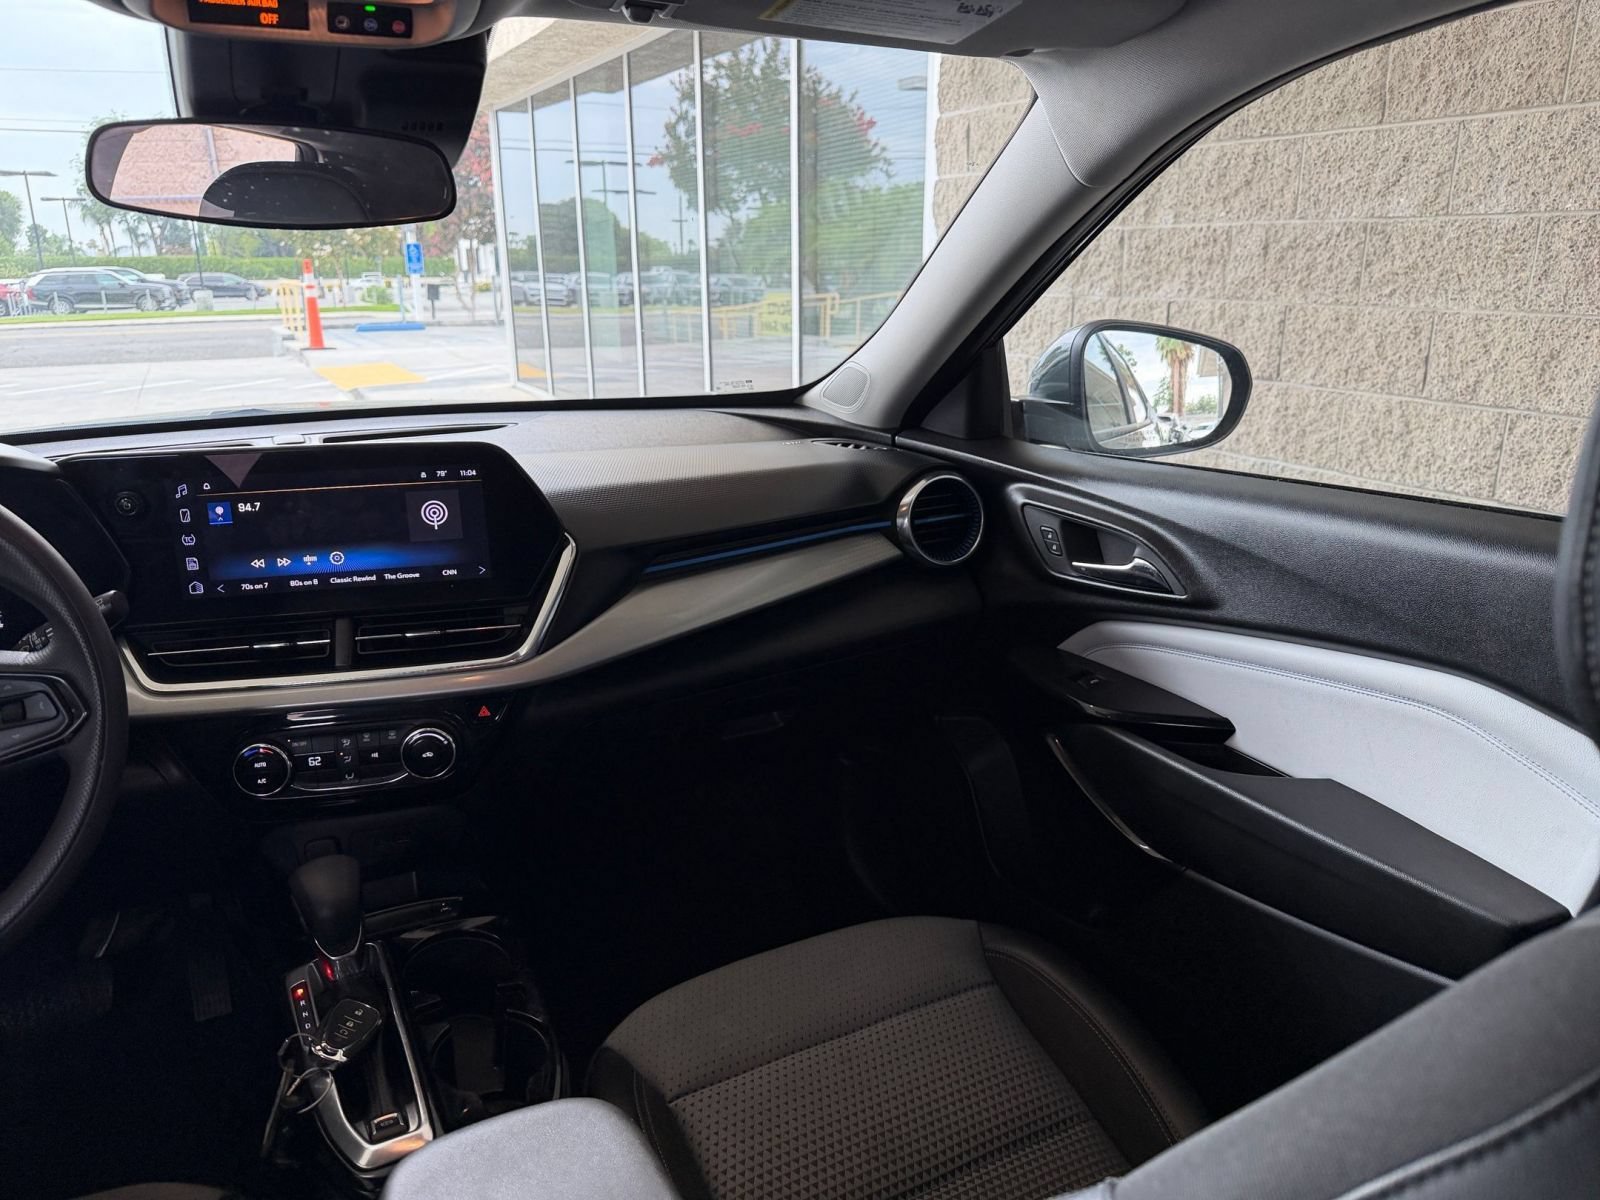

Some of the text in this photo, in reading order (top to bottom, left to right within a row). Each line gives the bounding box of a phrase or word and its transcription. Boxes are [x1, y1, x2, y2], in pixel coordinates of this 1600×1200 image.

[260, 12, 279, 24] OFF
[238, 502, 260, 512] 94.7
[330, 574, 376, 584] Classic Rewind
[308, 757, 321, 766] 62
